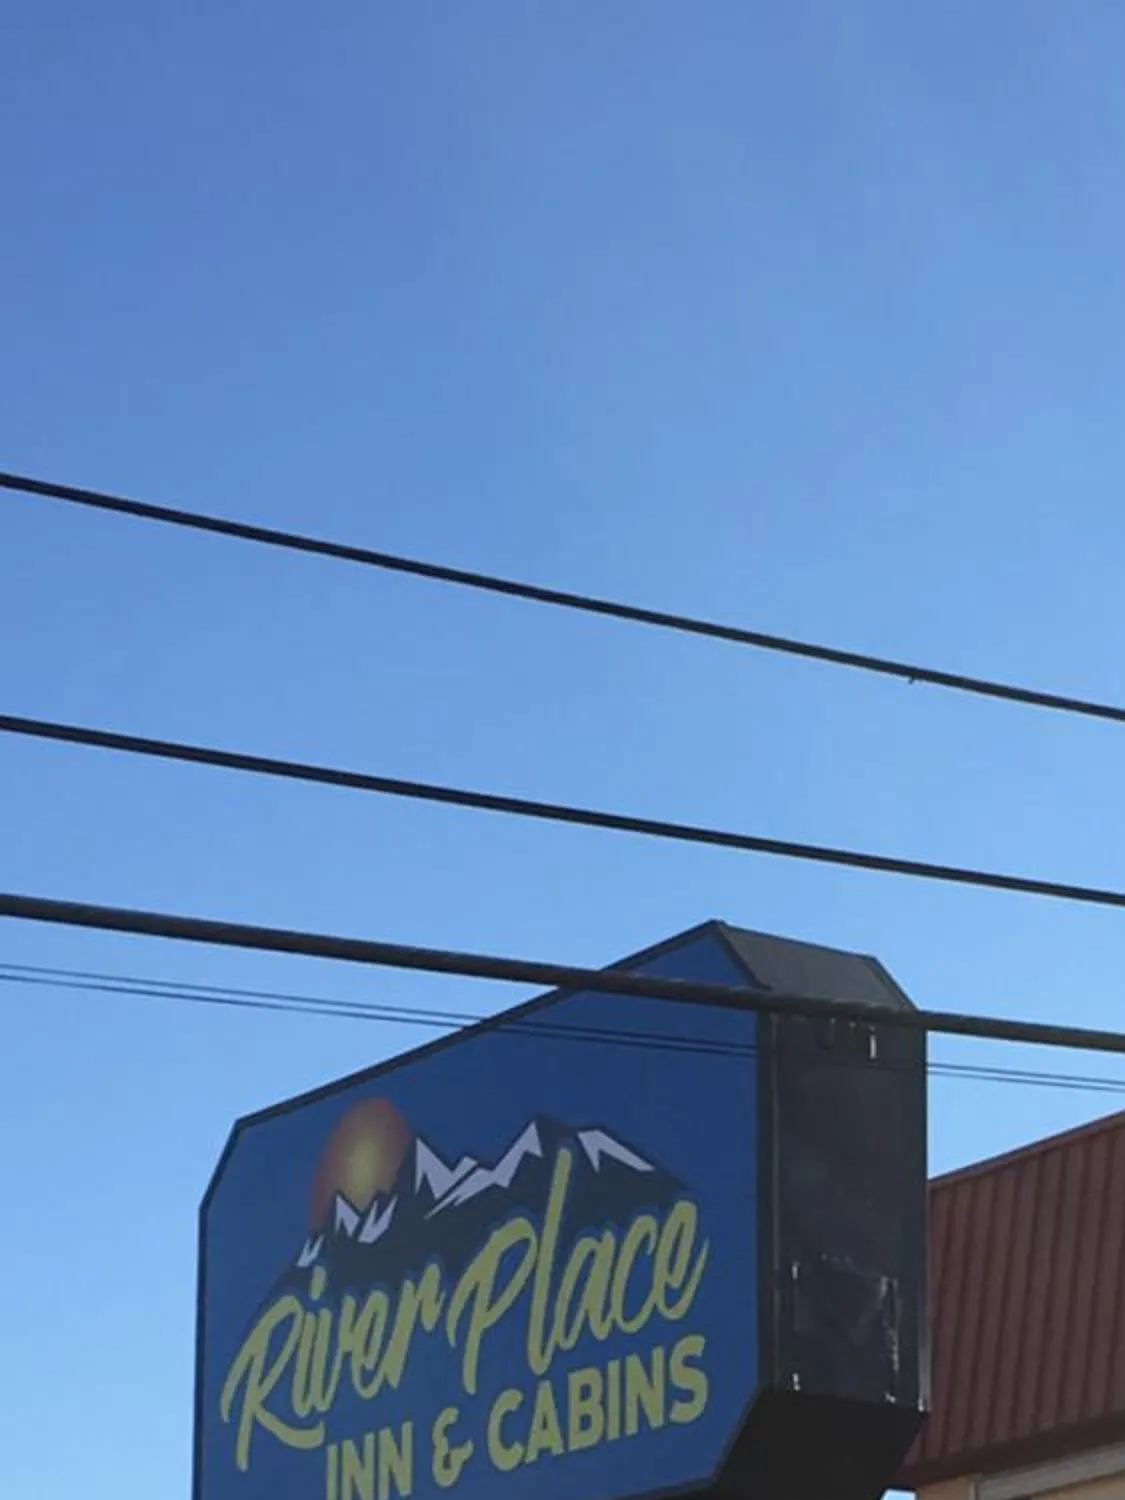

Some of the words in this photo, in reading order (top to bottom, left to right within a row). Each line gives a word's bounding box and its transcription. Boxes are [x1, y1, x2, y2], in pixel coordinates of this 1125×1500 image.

[220, 1264, 446, 1471] River
[446, 1148, 710, 1395] Place
[432, 1407, 473, 1487] &
[488, 1335, 709, 1471] CABINS
